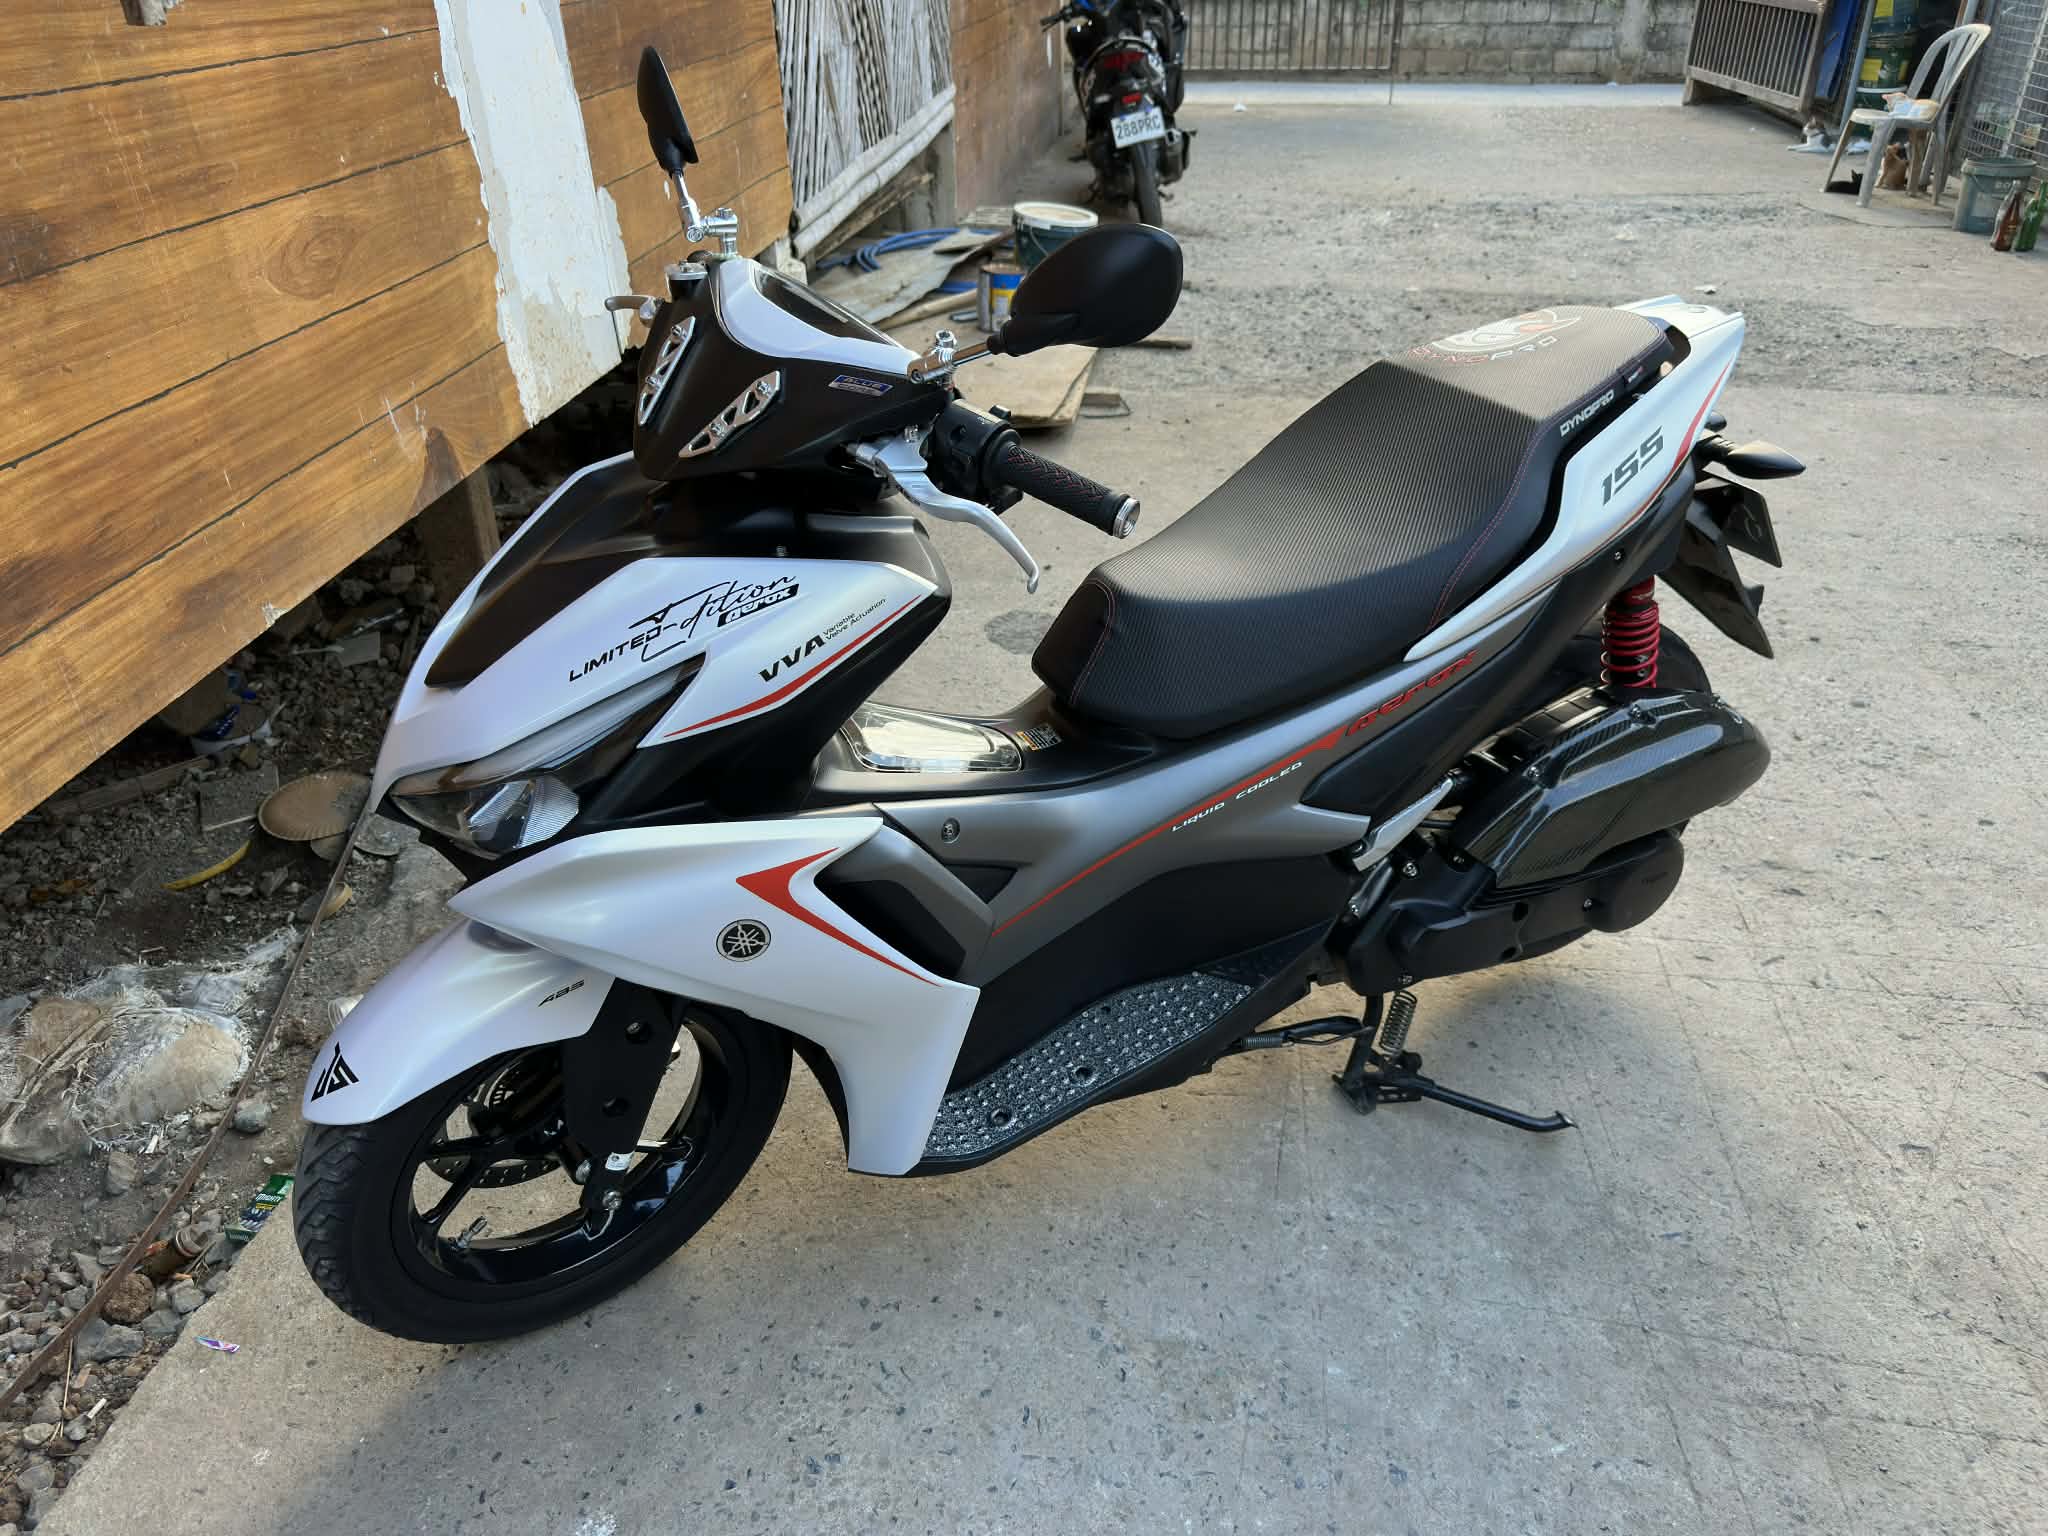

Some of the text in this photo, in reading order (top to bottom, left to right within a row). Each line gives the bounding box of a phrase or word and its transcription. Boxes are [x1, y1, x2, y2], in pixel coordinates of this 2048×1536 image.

[1560, 389, 1615, 437] DYNOPRO
[1600, 425, 1664, 506] 155
[822, 613, 857, 637] Variable
[824, 599, 888, 641] Valve Actuation
[569, 624, 663, 683] LIMITED
[759, 634, 826, 682] VVA
[1172, 761, 1304, 833] LIQUID COOLED
